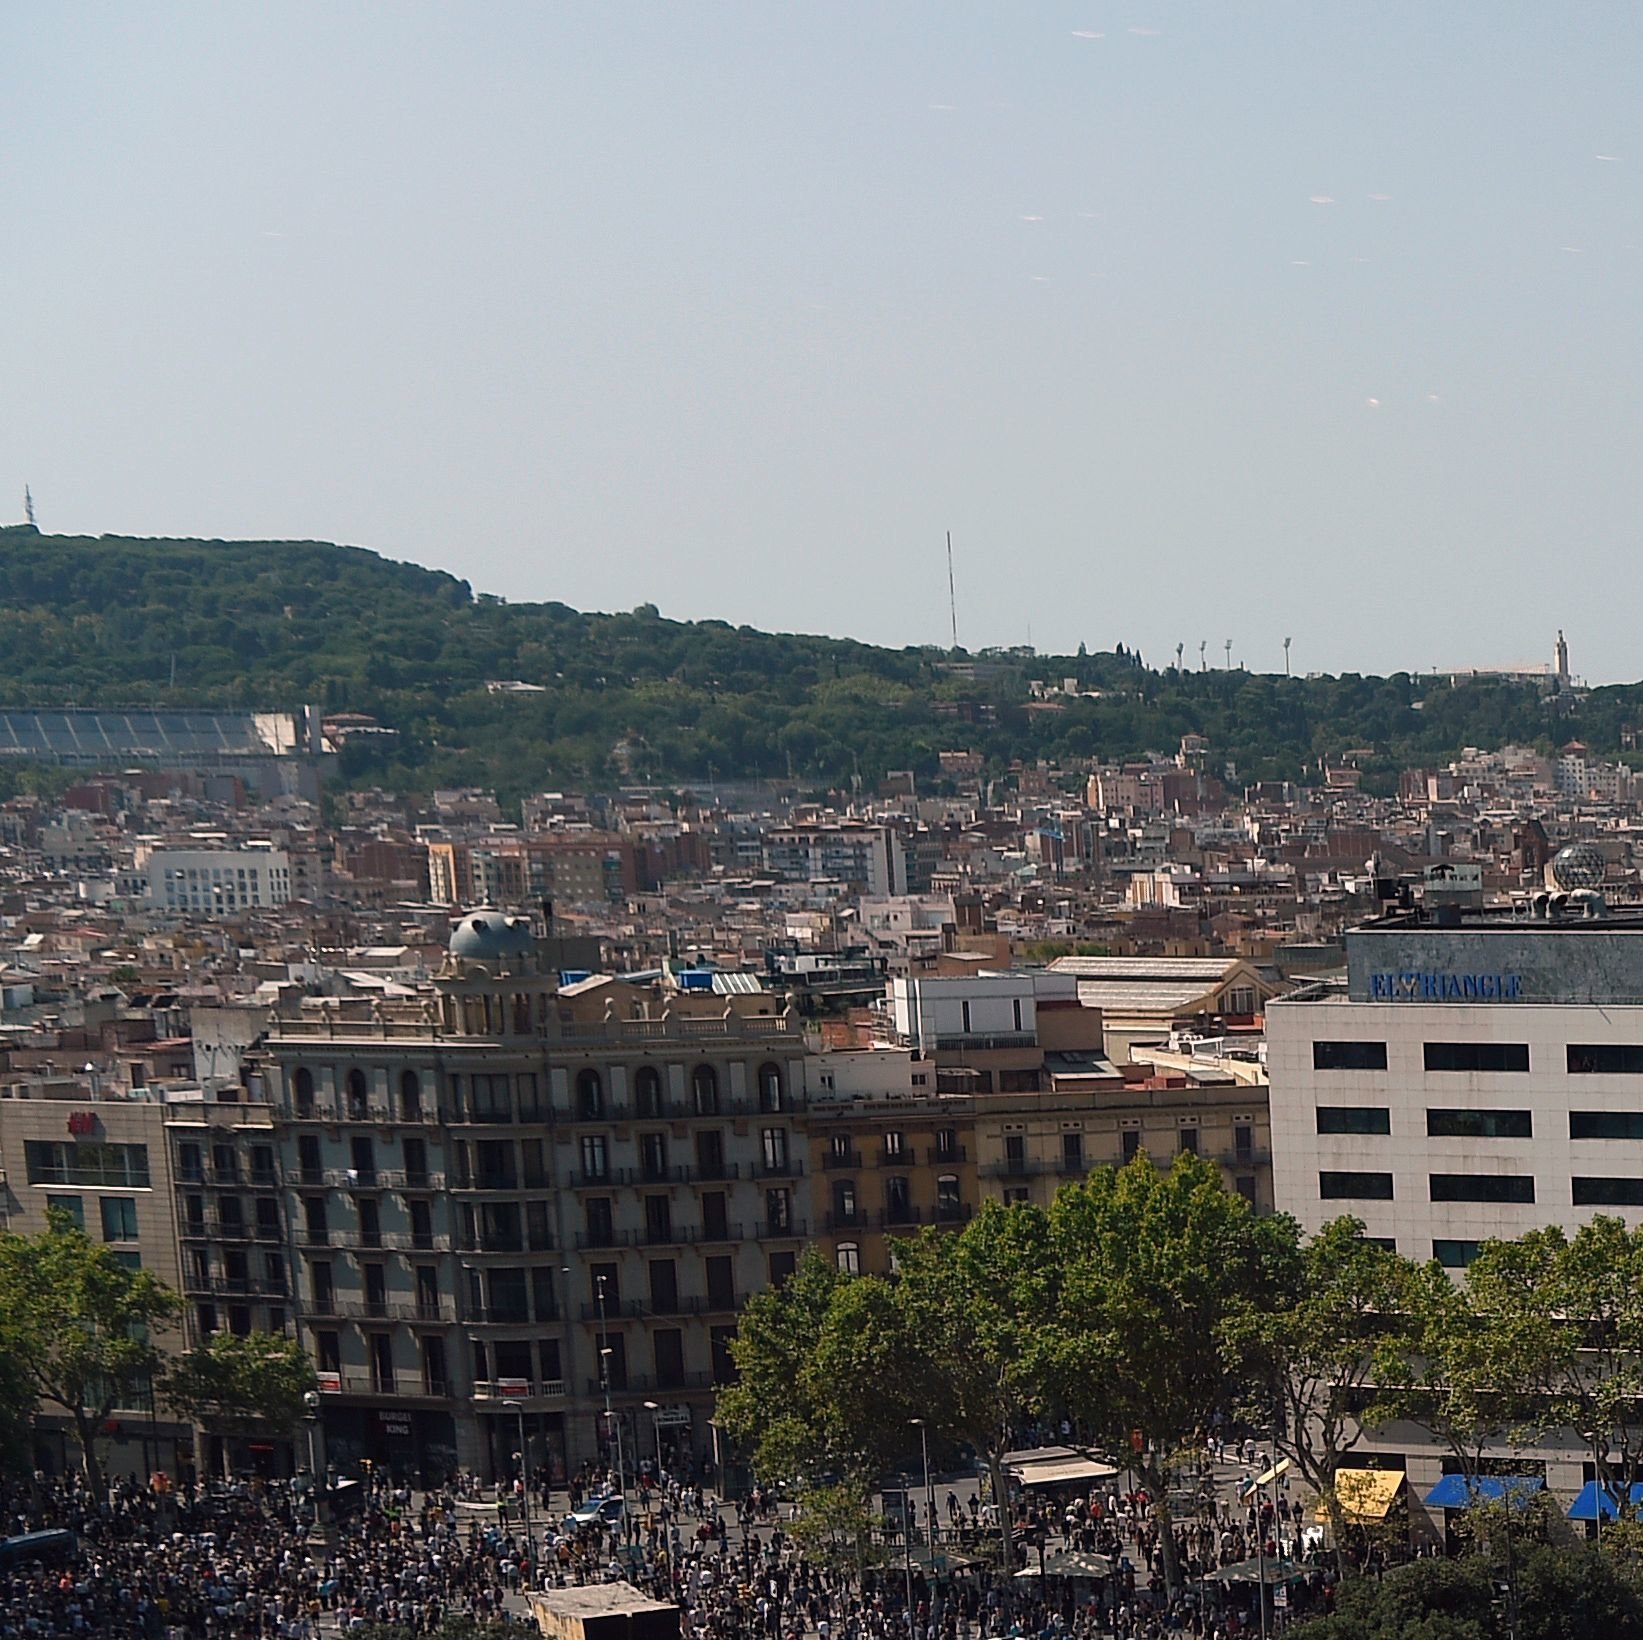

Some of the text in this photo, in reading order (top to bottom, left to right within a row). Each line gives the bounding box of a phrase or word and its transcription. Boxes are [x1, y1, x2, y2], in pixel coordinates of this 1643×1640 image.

[1370, 973, 1523, 998] EL TRIANGLE
[386, 1423, 409, 1435] KING
